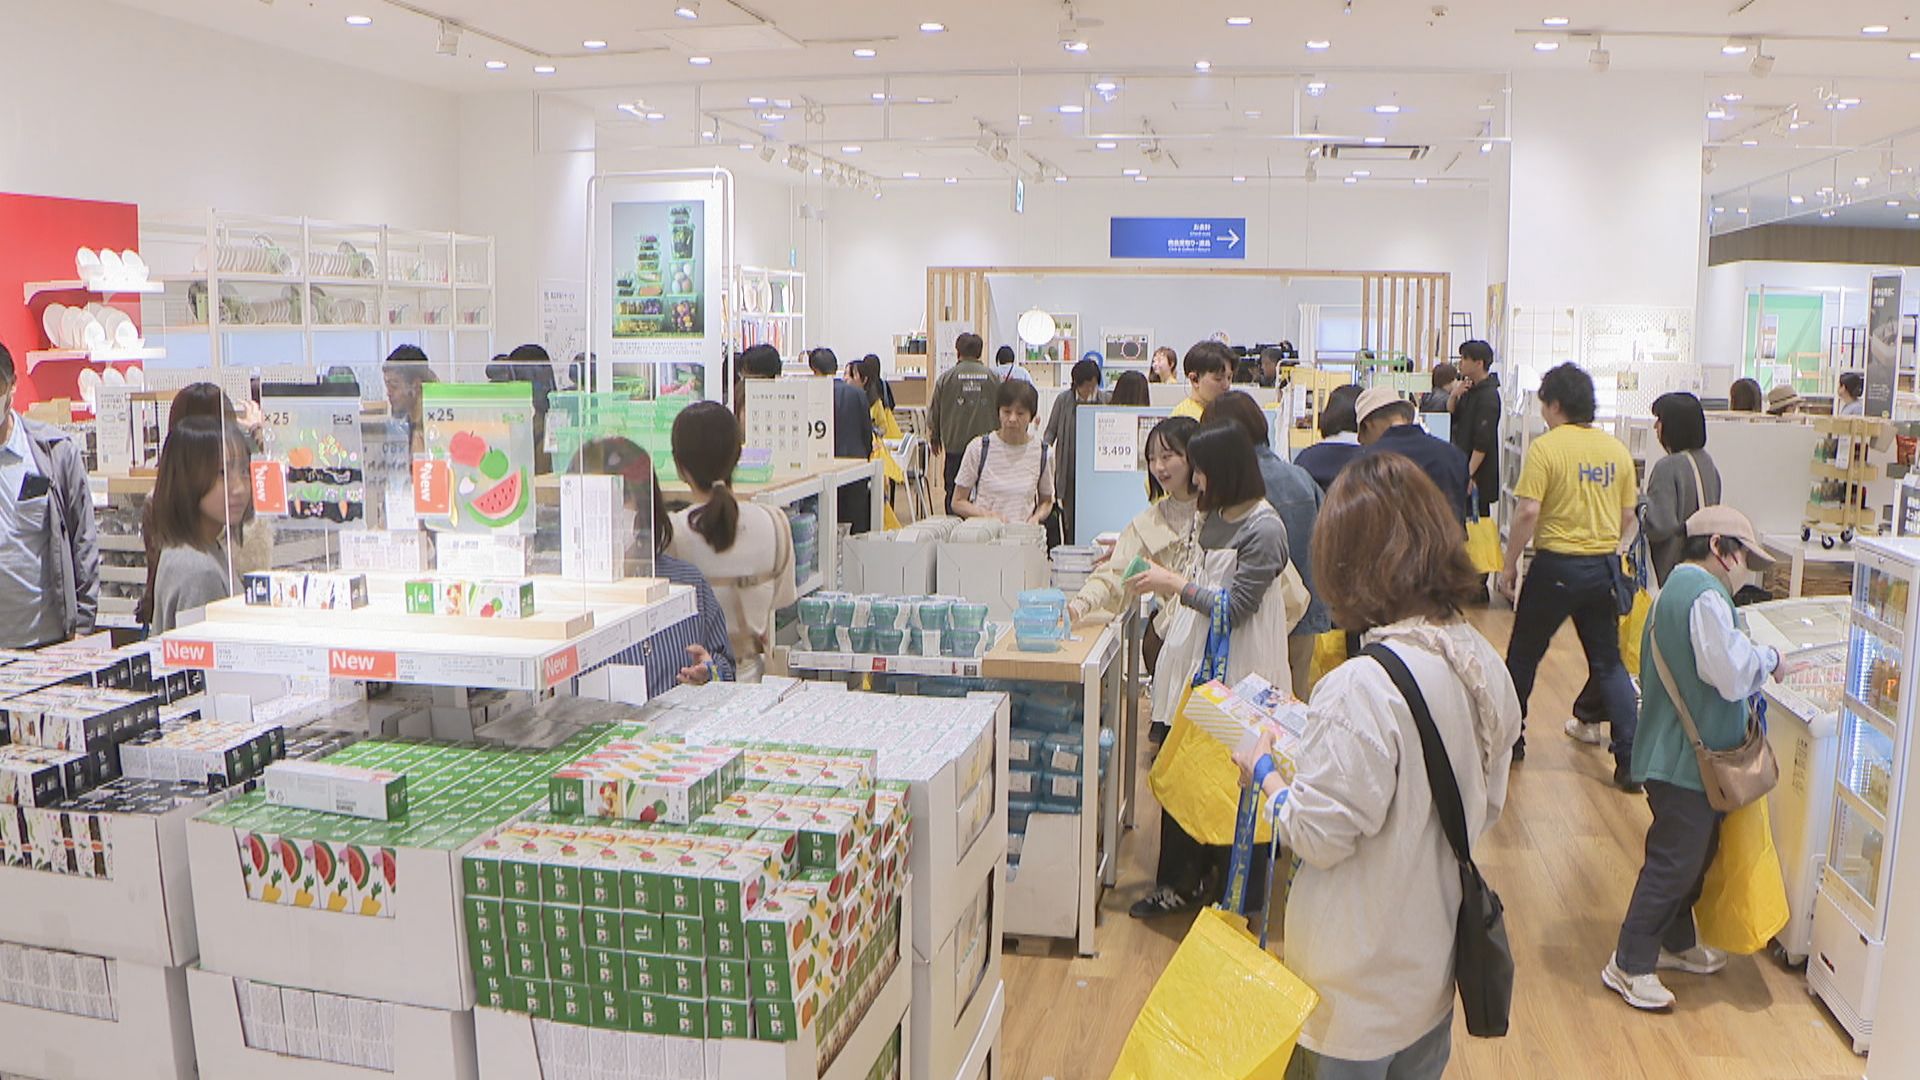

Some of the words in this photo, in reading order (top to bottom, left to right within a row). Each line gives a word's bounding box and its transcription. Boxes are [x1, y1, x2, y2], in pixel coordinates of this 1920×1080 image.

[255, 466, 266, 502] New
[420, 463, 433, 502] New
[1578, 462, 1616, 488] Hej!
[165, 641, 205, 661] New
[332, 651, 375, 671] New
[545, 655, 568, 676] New
